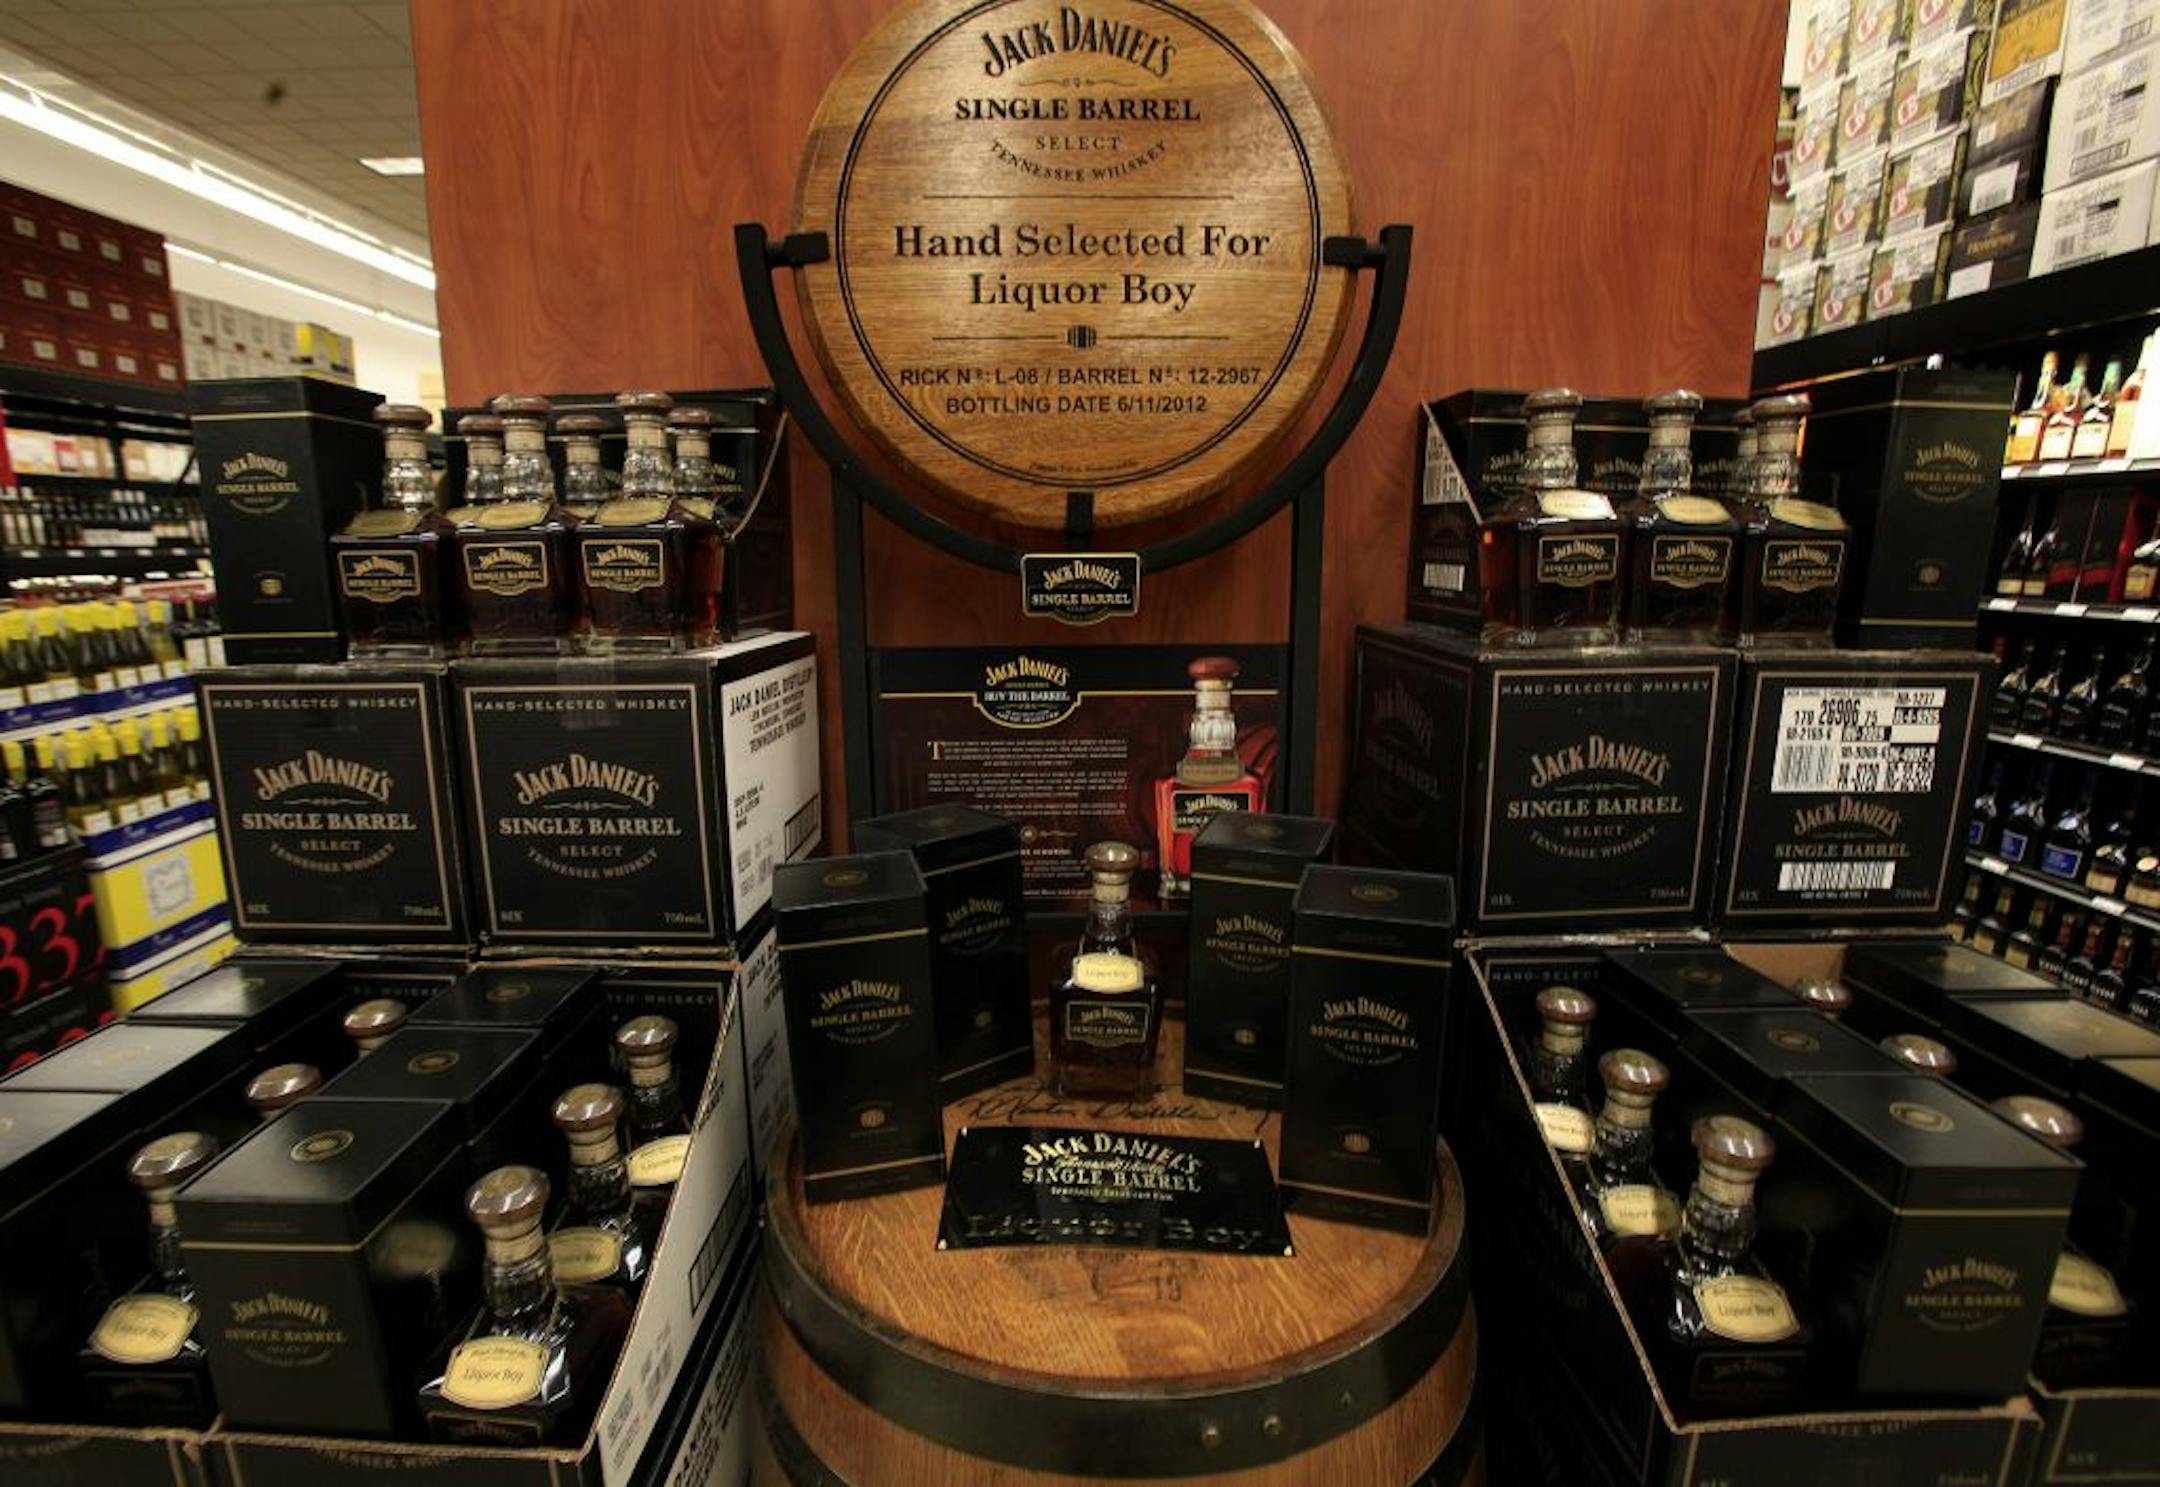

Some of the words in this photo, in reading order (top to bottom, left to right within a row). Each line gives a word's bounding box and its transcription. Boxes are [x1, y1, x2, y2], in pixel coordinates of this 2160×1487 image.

[980, 20, 1056, 78] JACK
[1060, 6, 1177, 79] DANIEL'S
[955, 98, 1069, 120] SINGLE
[1078, 98, 1201, 120] BARREL
[1036, 136, 1122, 151] SELECT
[990, 137, 1085, 183] TENNESSEE
[1092, 139, 1167, 181] WHISKEY
[893, 224, 1002, 258] Hand
[1016, 222, 1185, 258] Selected
[1200, 224, 1271, 257] For
[969, 272, 1108, 313] Liquor
[1121, 273, 1197, 313] Boy
[900, 368, 949, 385] RICK
[995, 368, 1039, 384] L-08
[1058, 368, 1141, 385] BARREL
[1188, 368, 1261, 385] 12-2967
[946, 396, 1050, 415] BOTTLING
[1057, 396, 1111, 414] DATE
[1117, 396, 1207, 413] 6/11/2012
[1042, 564, 1074, 590] JACK
[1073, 559, 1121, 590] DANIEL'S
[1031, 592, 1080, 606] SINGLE
[1081, 592, 1132, 605] BARREL
[986, 661, 1018, 686] JACK
[1501, 681, 1633, 696] HAND-SELECTED
[1642, 680, 1711, 693] WHISKEY
[211, 698, 340, 711] HAND-SELECTED
[347, 696, 418, 709] WHISKEY
[474, 699, 606, 712] HAND-SELECTED
[616, 698, 690, 710] WHISKEY
[1529, 744, 1585, 789] JACK
[1587, 734, 1672, 788] DANIEL'S
[253, 758, 307, 801] JACK
[305, 749, 395, 803] DANIEL'S
[512, 761, 570, 806] JACK
[569, 752, 660, 809] DANIEL'S
[1506, 798, 1591, 820] SINGLE
[1595, 796, 1684, 816] BARREL
[1794, 803, 1837, 837] JACK
[1838, 795, 1903, 837] DANIEL'S
[241, 812, 325, 831] SINGLE
[327, 812, 418, 831] BARREL
[499, 816, 584, 837] SINGLE
[589, 816, 683, 837] BARREL
[1564, 825, 1625, 838] SELECT
[300, 839, 362, 851] SELECT
[559, 844, 624, 858] SELECT
[1775, 844, 1839, 858] SINGLE
[1842, 843, 1911, 858] BARREL
[1323, 1000, 1358, 1023] JACK
[1021, 1136, 1090, 1166] JACK
[1093, 1132, 1203, 1175] DANIEL'S
[1021, 1166, 1103, 1185] SINGLE
[1112, 1169, 1202, 1193] BARREL
